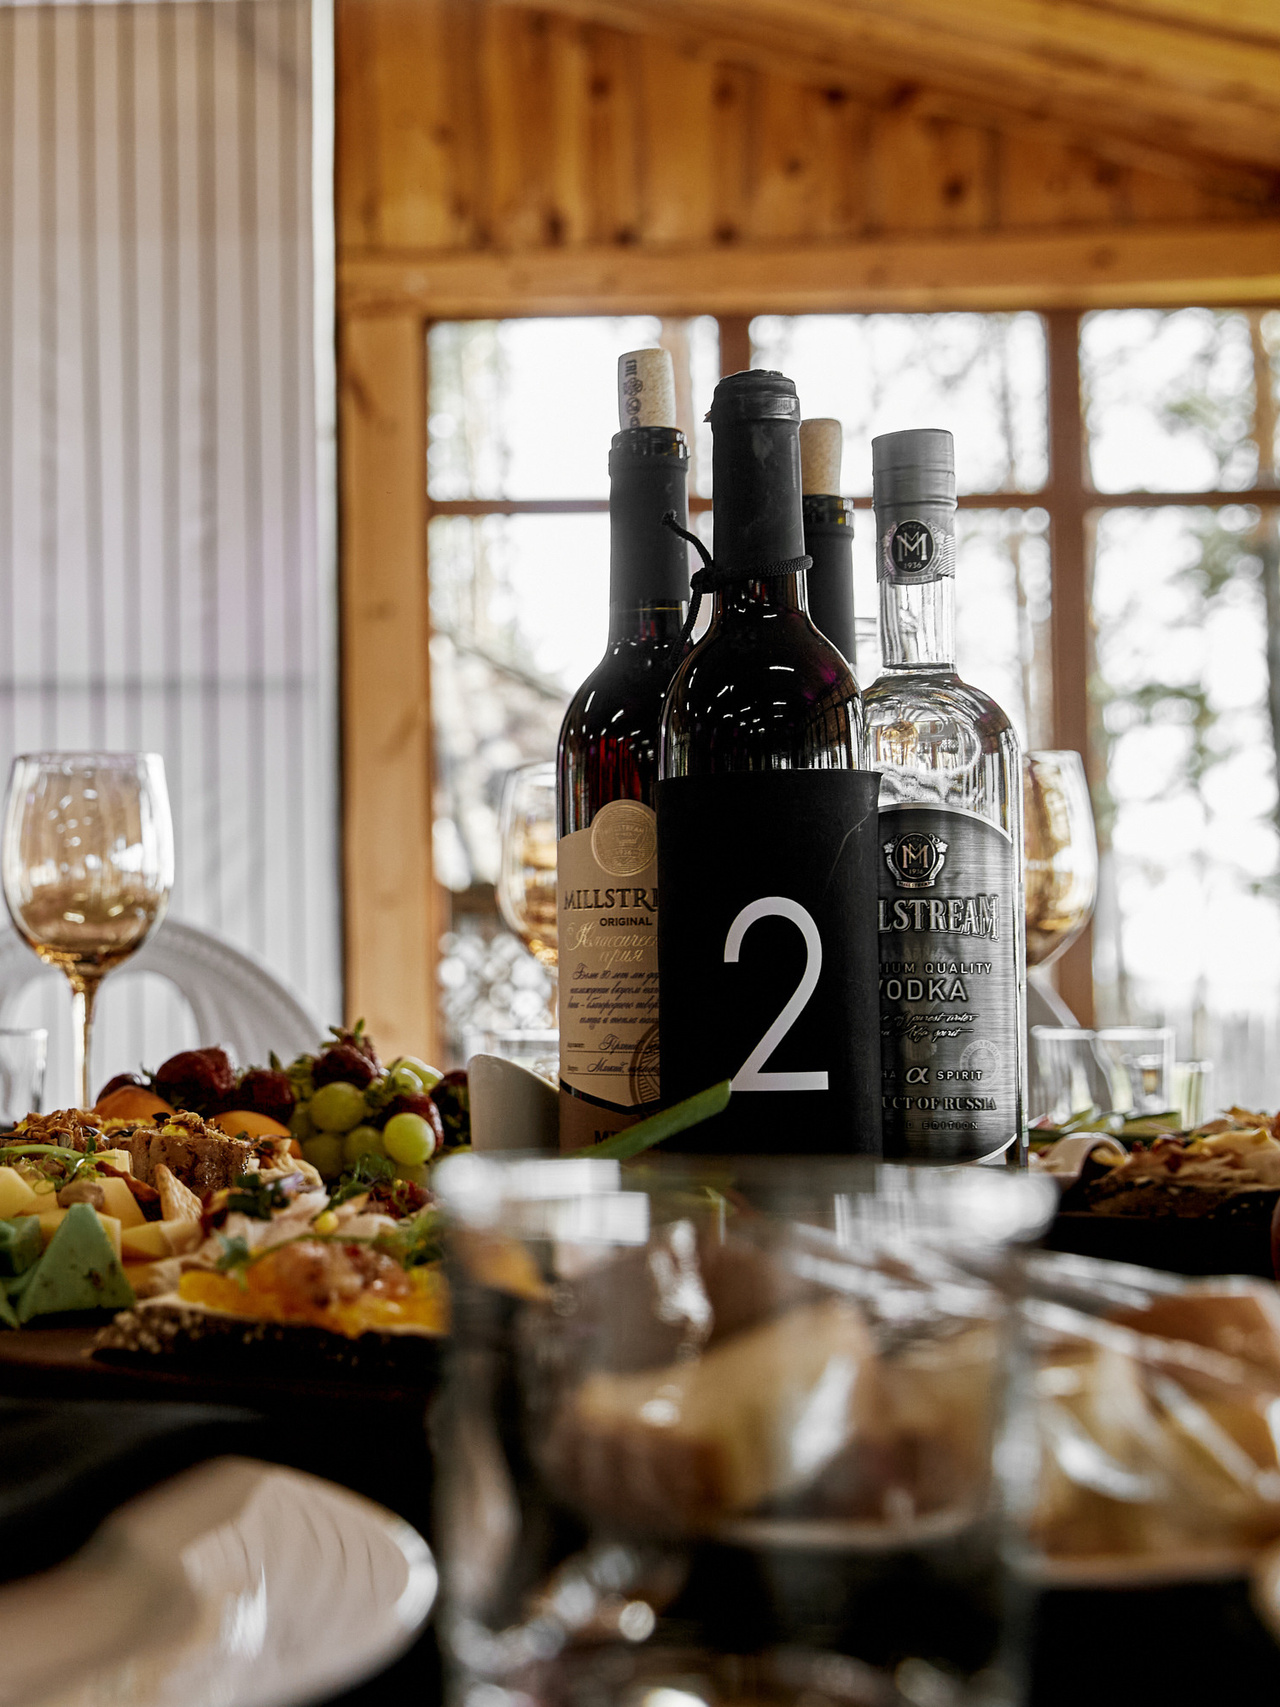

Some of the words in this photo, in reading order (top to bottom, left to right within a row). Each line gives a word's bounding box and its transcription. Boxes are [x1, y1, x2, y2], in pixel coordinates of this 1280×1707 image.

[903, 561, 922, 570] 1936
[599, 917, 653, 927] ORIGINAL
[925, 963, 992, 974] QUALITY
[724, 896, 829, 1091] 2
[937, 1070, 983, 1080] SPIRIT
[917, 1096, 940, 1110] OF
[943, 1096, 997, 1111] RUSSIA
[922, 1121, 979, 1130] EDITION
